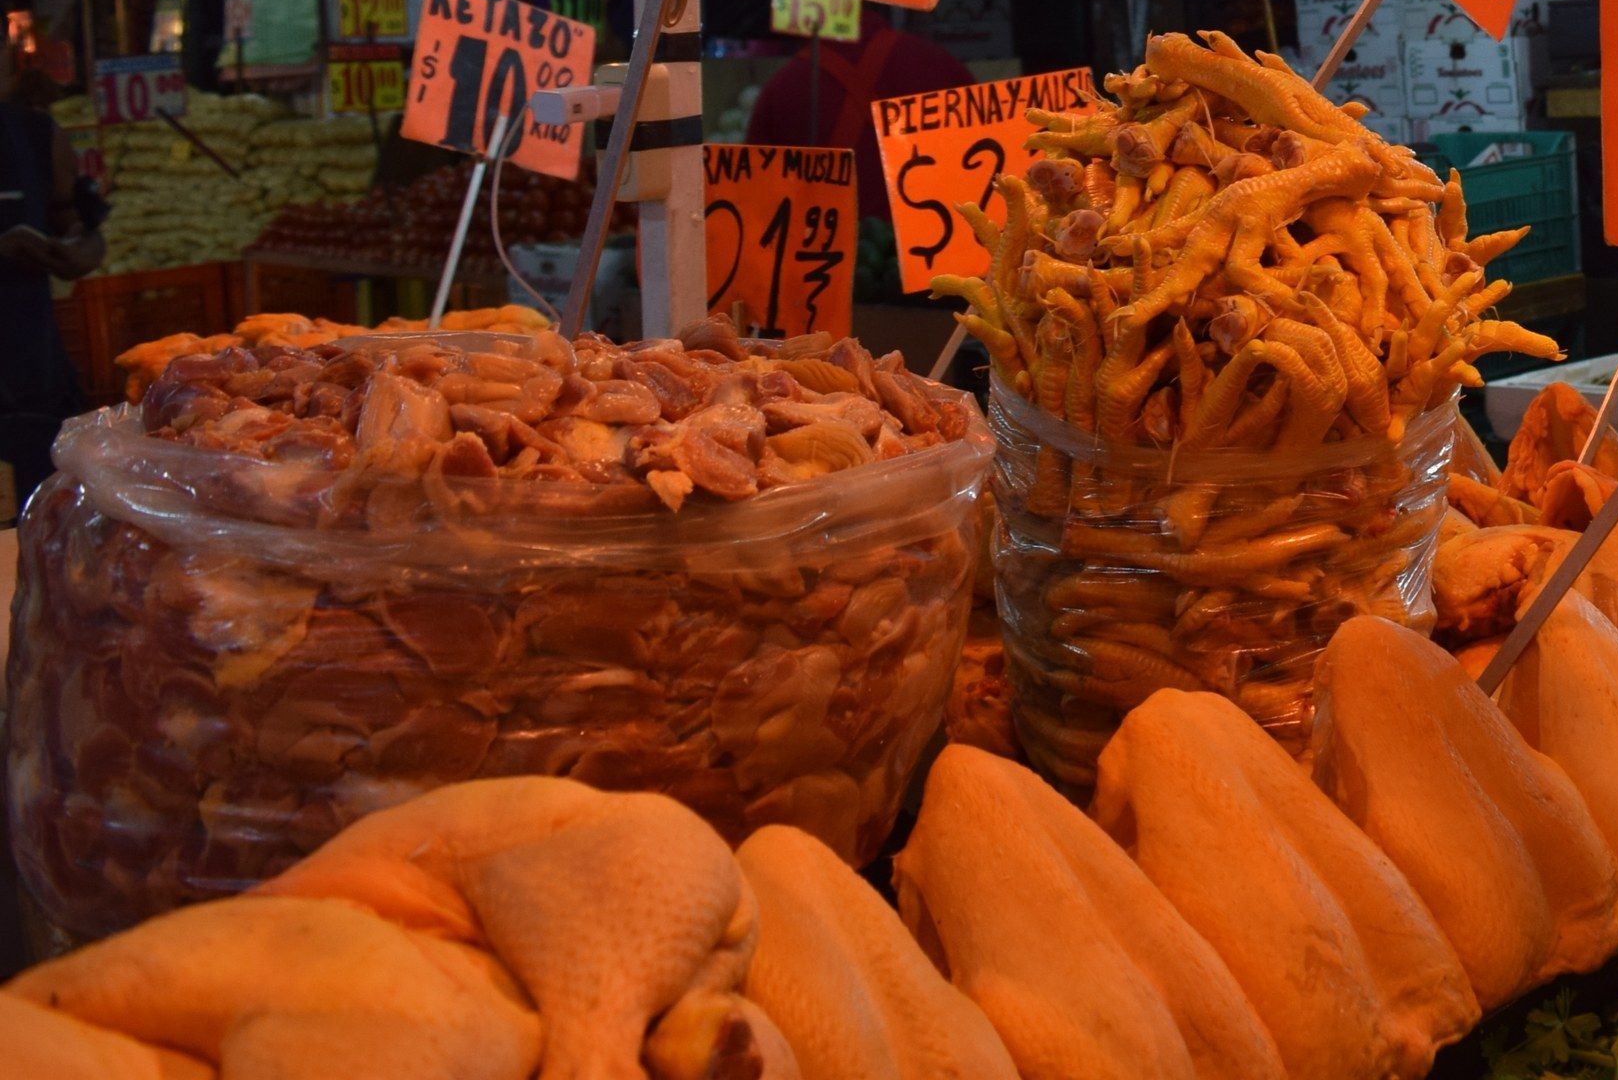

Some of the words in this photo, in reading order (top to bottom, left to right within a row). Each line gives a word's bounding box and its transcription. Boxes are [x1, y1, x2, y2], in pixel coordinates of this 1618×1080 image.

[101, 72, 148, 125] 10
[438, 35, 527, 158] 10
[758, 148, 777, 170] Y
[782, 151, 852, 186] MUSLO
